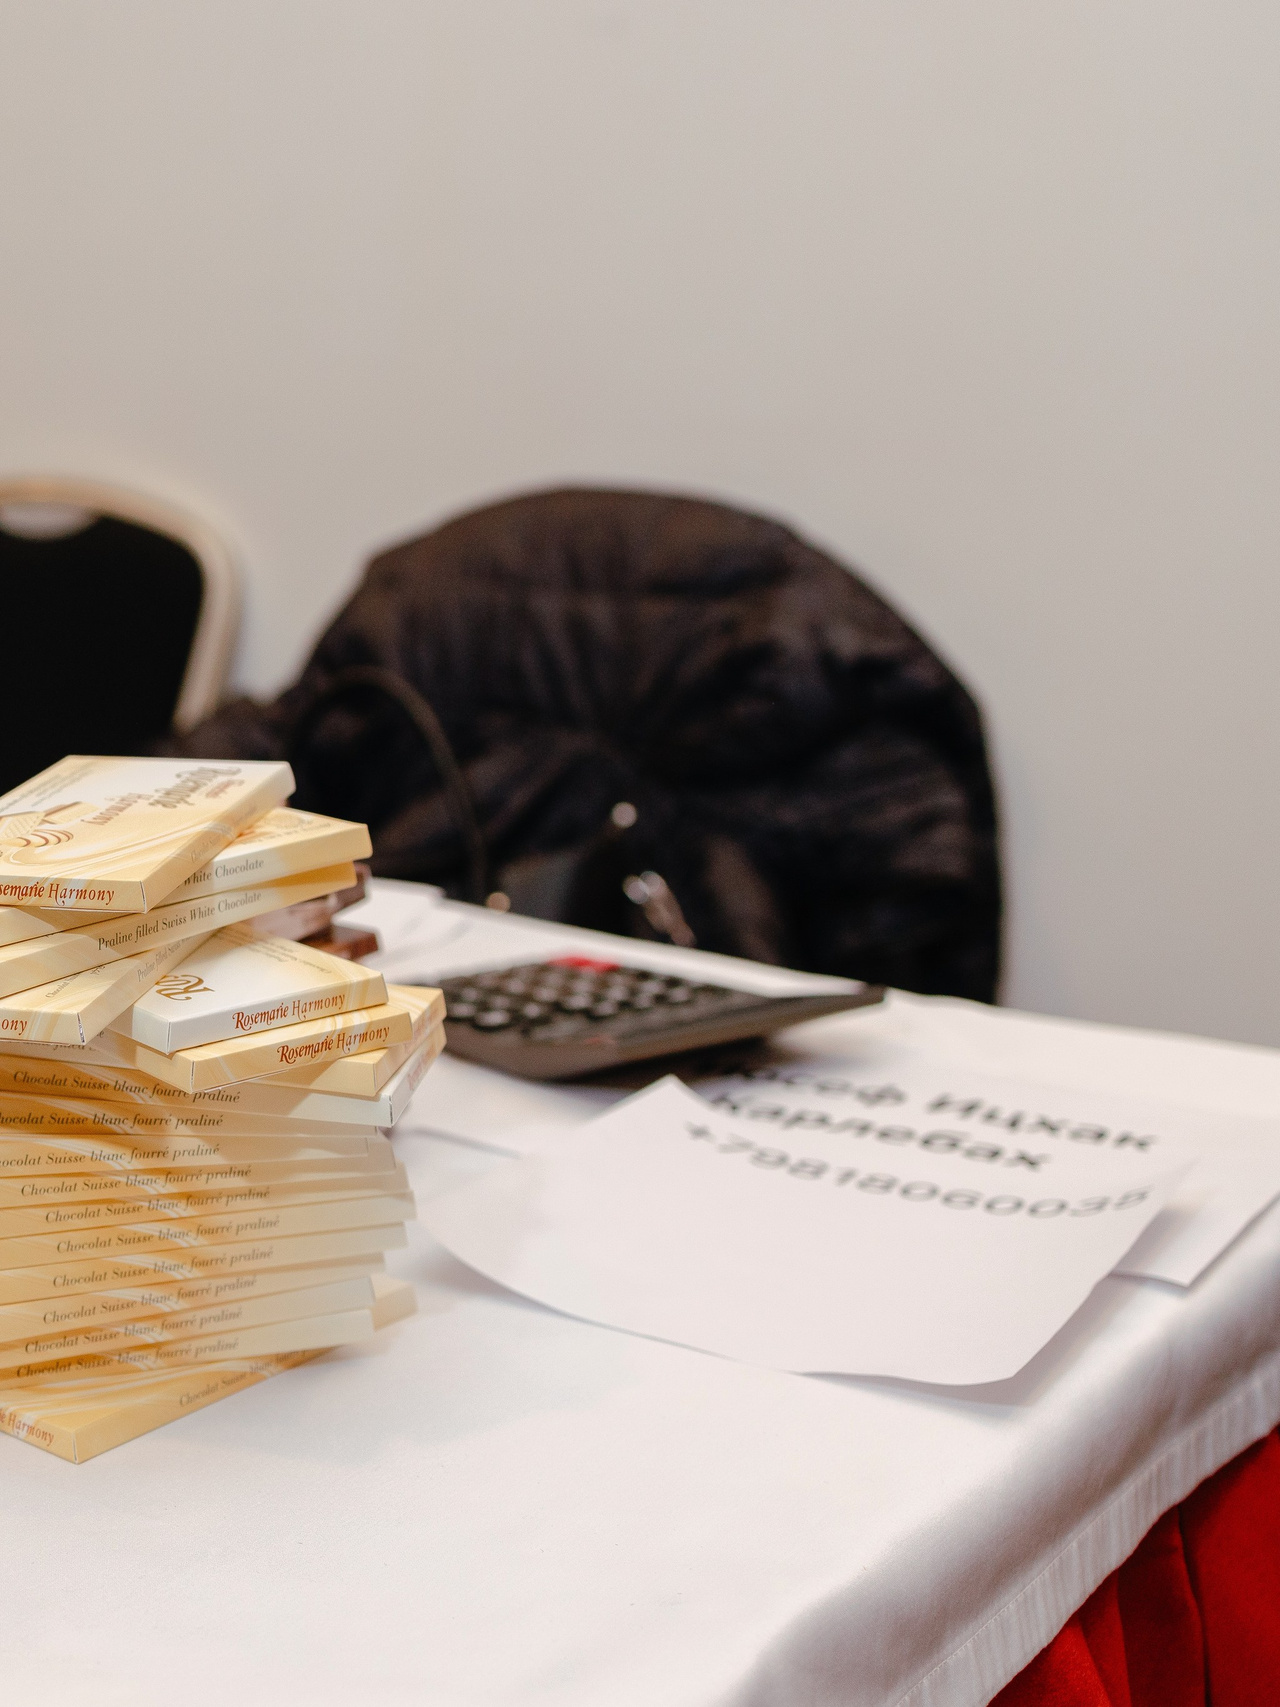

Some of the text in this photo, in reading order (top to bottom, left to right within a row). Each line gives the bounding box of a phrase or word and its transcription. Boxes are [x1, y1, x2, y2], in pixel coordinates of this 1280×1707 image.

[214, 858, 265, 880] Chocolate
[48, 883, 115, 906] Harmony
[98, 892, 262, 951] Praline filled Swiss White Chocolate
[232, 993, 346, 1031] Rosemarie Harmony
[277, 1035, 334, 1065] Rosemarie
[336, 1026, 390, 1055] Harmony
[14, 1070, 68, 1088] Chocolat
[70, 1075, 110, 1092] Suisse
[113, 1080, 149, 1095] blanc
[192, 1088, 241, 1103] praliné
[47, 1112, 89, 1126] Suisse
[92, 1112, 129, 1126] blanc
[131, 1113, 172, 1128] fourré
[175, 1113, 224, 1129] praliné
[45, 1151, 86, 1165] Suisse
[90, 1148, 126, 1163] blanc
[129, 1146, 170, 1163] fourré
[172, 1143, 220, 1159] praliné
[21, 1165, 252, 1198] Chocolat Suisse blanc fourré praliné
[45, 1187, 270, 1225] Chocolat Suisse blanc fourré praliné
[56, 1215, 280, 1254] Chocolat Suisse blanc fourré praliné
[52, 1247, 274, 1289] Chocolat Suisse blanc fourré praliné
[43, 1275, 258, 1325] Chocolat Suisse blanc fourré praliné
[24, 1336, 80, 1355] Chocolat
[82, 1328, 121, 1346] Suisse
[123, 1321, 159, 1338] blanc
[7, 1412, 55, 1447] Harmony
